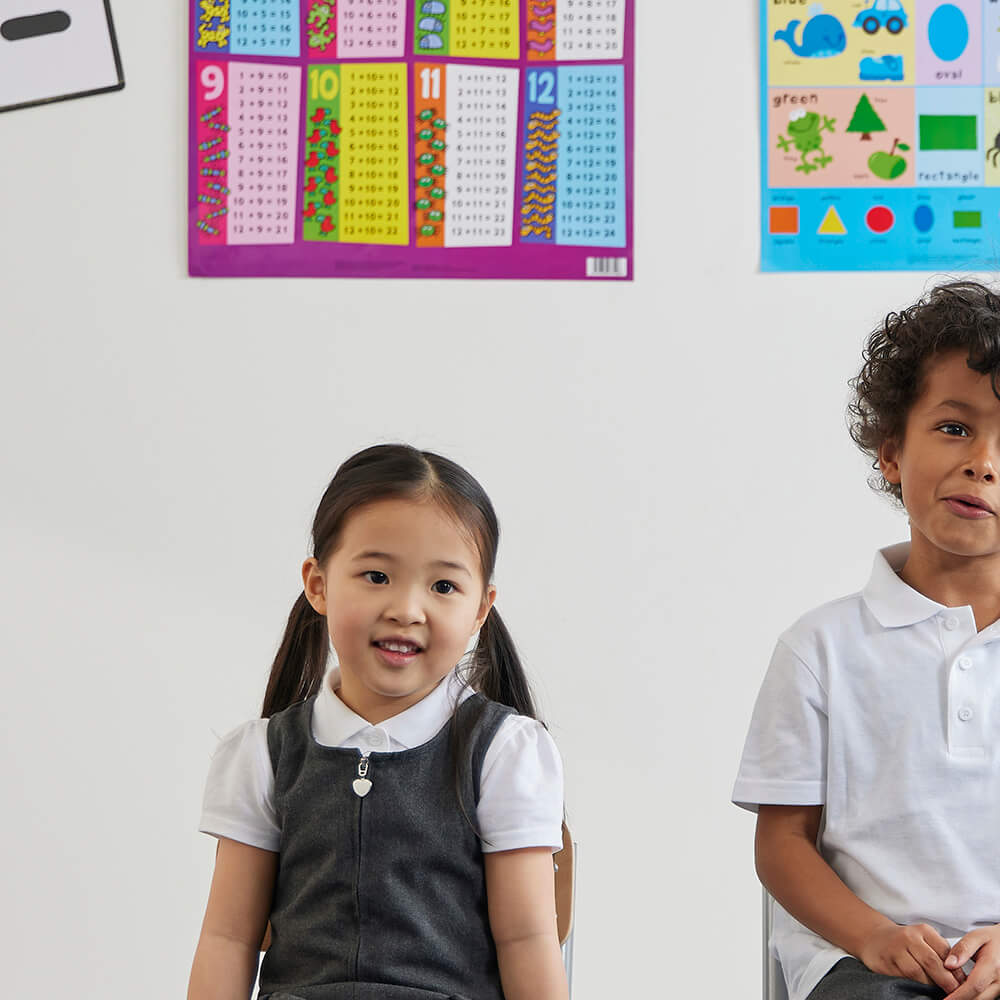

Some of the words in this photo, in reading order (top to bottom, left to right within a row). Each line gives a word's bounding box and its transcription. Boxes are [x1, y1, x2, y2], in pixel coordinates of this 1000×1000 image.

[201, 66, 224, 100] 9
[309, 69, 339, 100] 10
[420, 68, 440, 99] 11
[528, 72, 554, 104] 12
[936, 70, 962, 80] oval
[774, 94, 818, 108] green
[918, 170, 979, 183] rectangle
